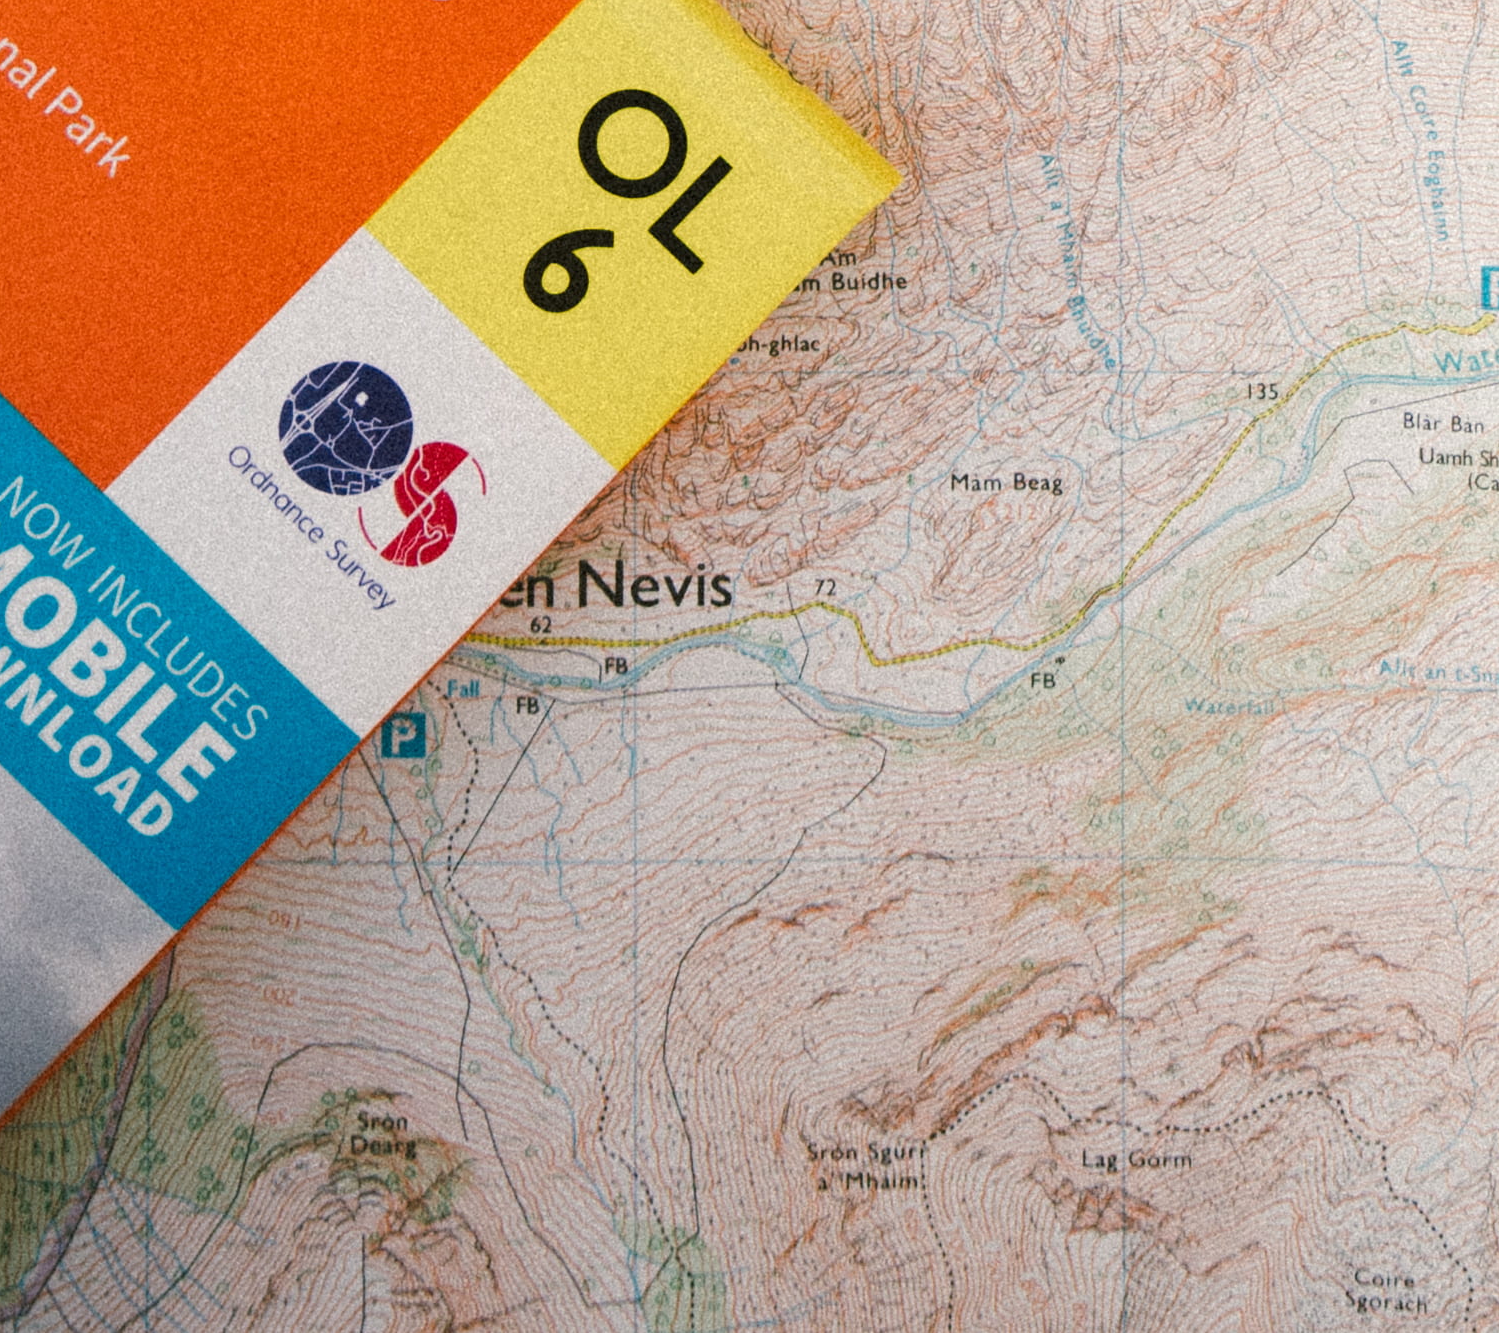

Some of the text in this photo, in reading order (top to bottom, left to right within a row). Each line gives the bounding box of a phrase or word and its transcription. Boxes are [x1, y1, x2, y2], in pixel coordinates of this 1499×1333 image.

[43, 83, 132, 179] Park
[576, 87, 735, 276] OL
[521, 227, 617, 315] 6
[228, 444, 326, 547] Ordnance
[329, 541, 398, 613] Survey
[576, 558, 735, 610] Nevis
[89, 563, 270, 741] INCLUDES
